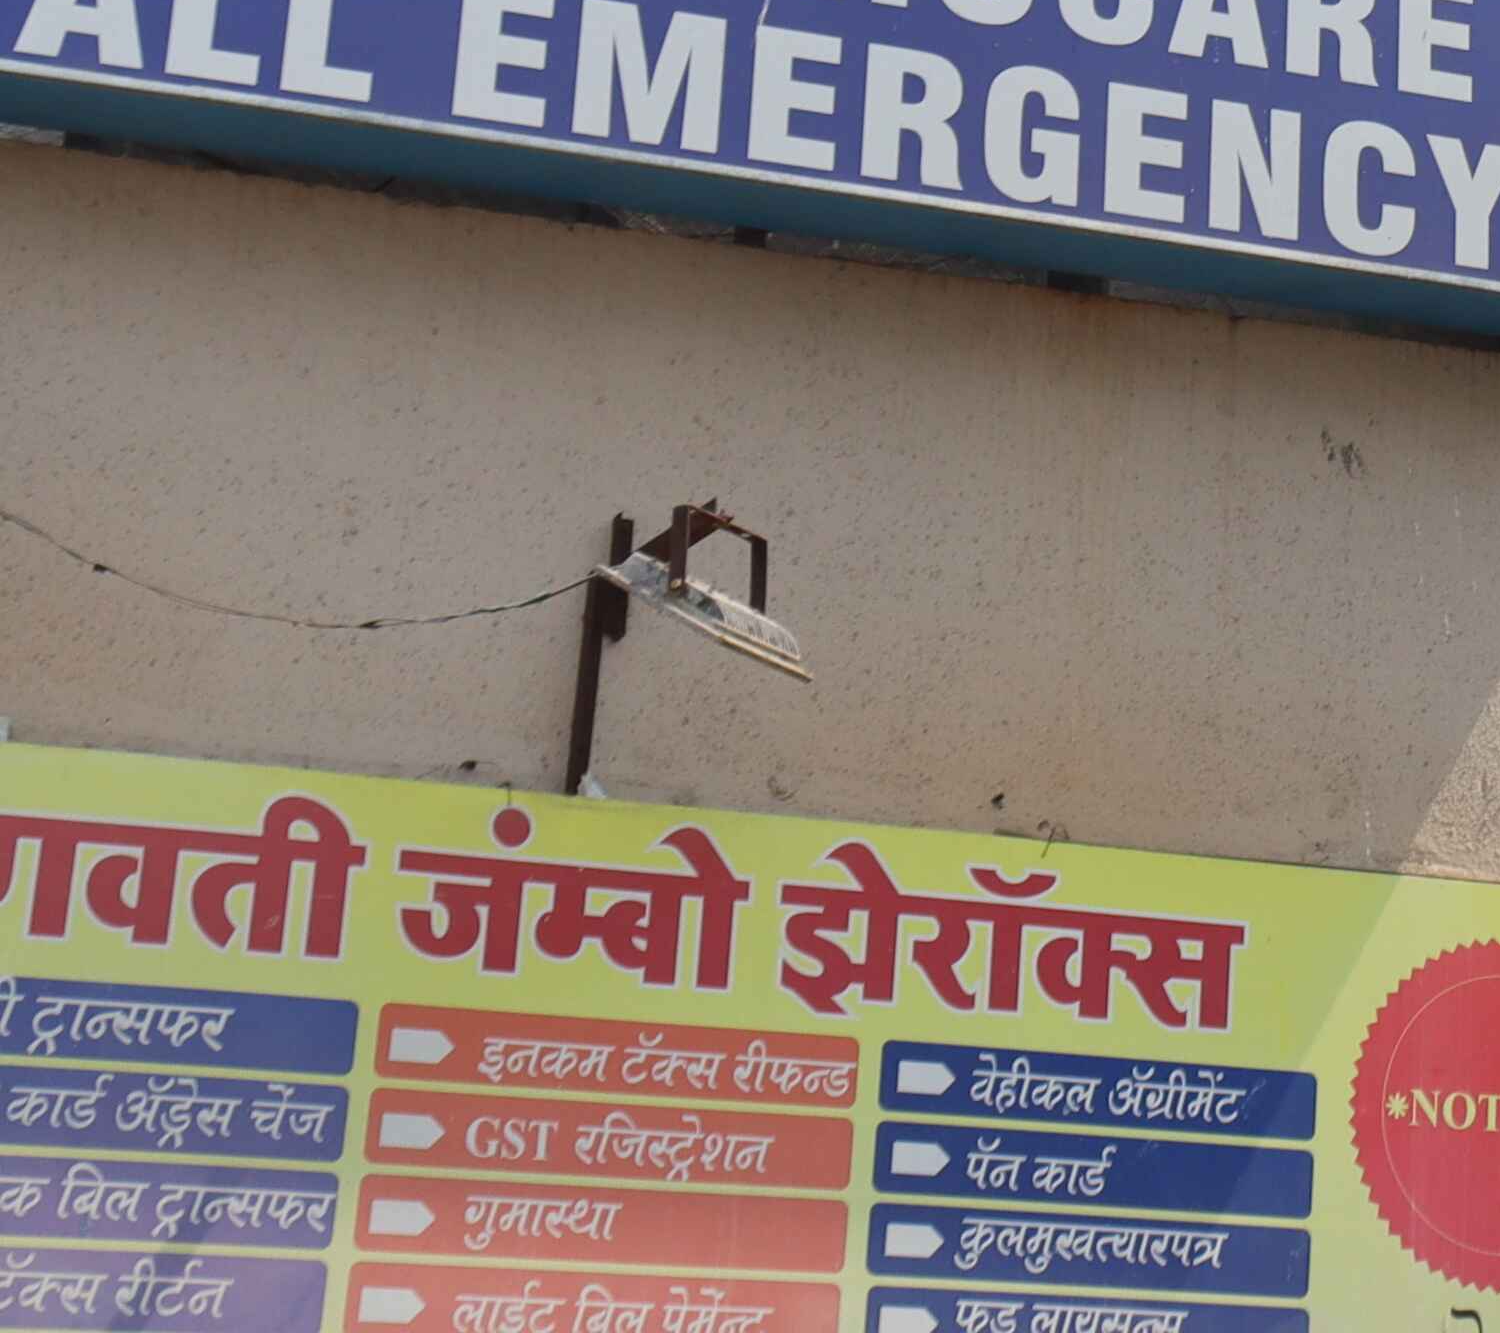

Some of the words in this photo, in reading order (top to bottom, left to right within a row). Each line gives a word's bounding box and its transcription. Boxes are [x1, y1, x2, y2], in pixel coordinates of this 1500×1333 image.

[781, 841, 1246, 1031] झेरॉक्स
[26, 996, 236, 1056] ट्रान्सफर
[477, 1036, 615, 1083] इनकम
[621, 1032, 727, 1091] टॅक्स
[732, 1039, 859, 1099] रीफन्ड
[968, 1053, 1102, 1117] वेहीकल
[6, 1073, 115, 1129] कार्ड
[465, 1116, 559, 1163] GST
[57, 1163, 150, 1223] बिल
[152, 1183, 338, 1238] ट्रान्सफर
[966, 1147, 1028, 1192] पॅन
[1033, 1144, 1118, 1199] कार्ड
[463, 1193, 623, 1252] गुमास्था
[570, 1284, 655, 1333] बिल
